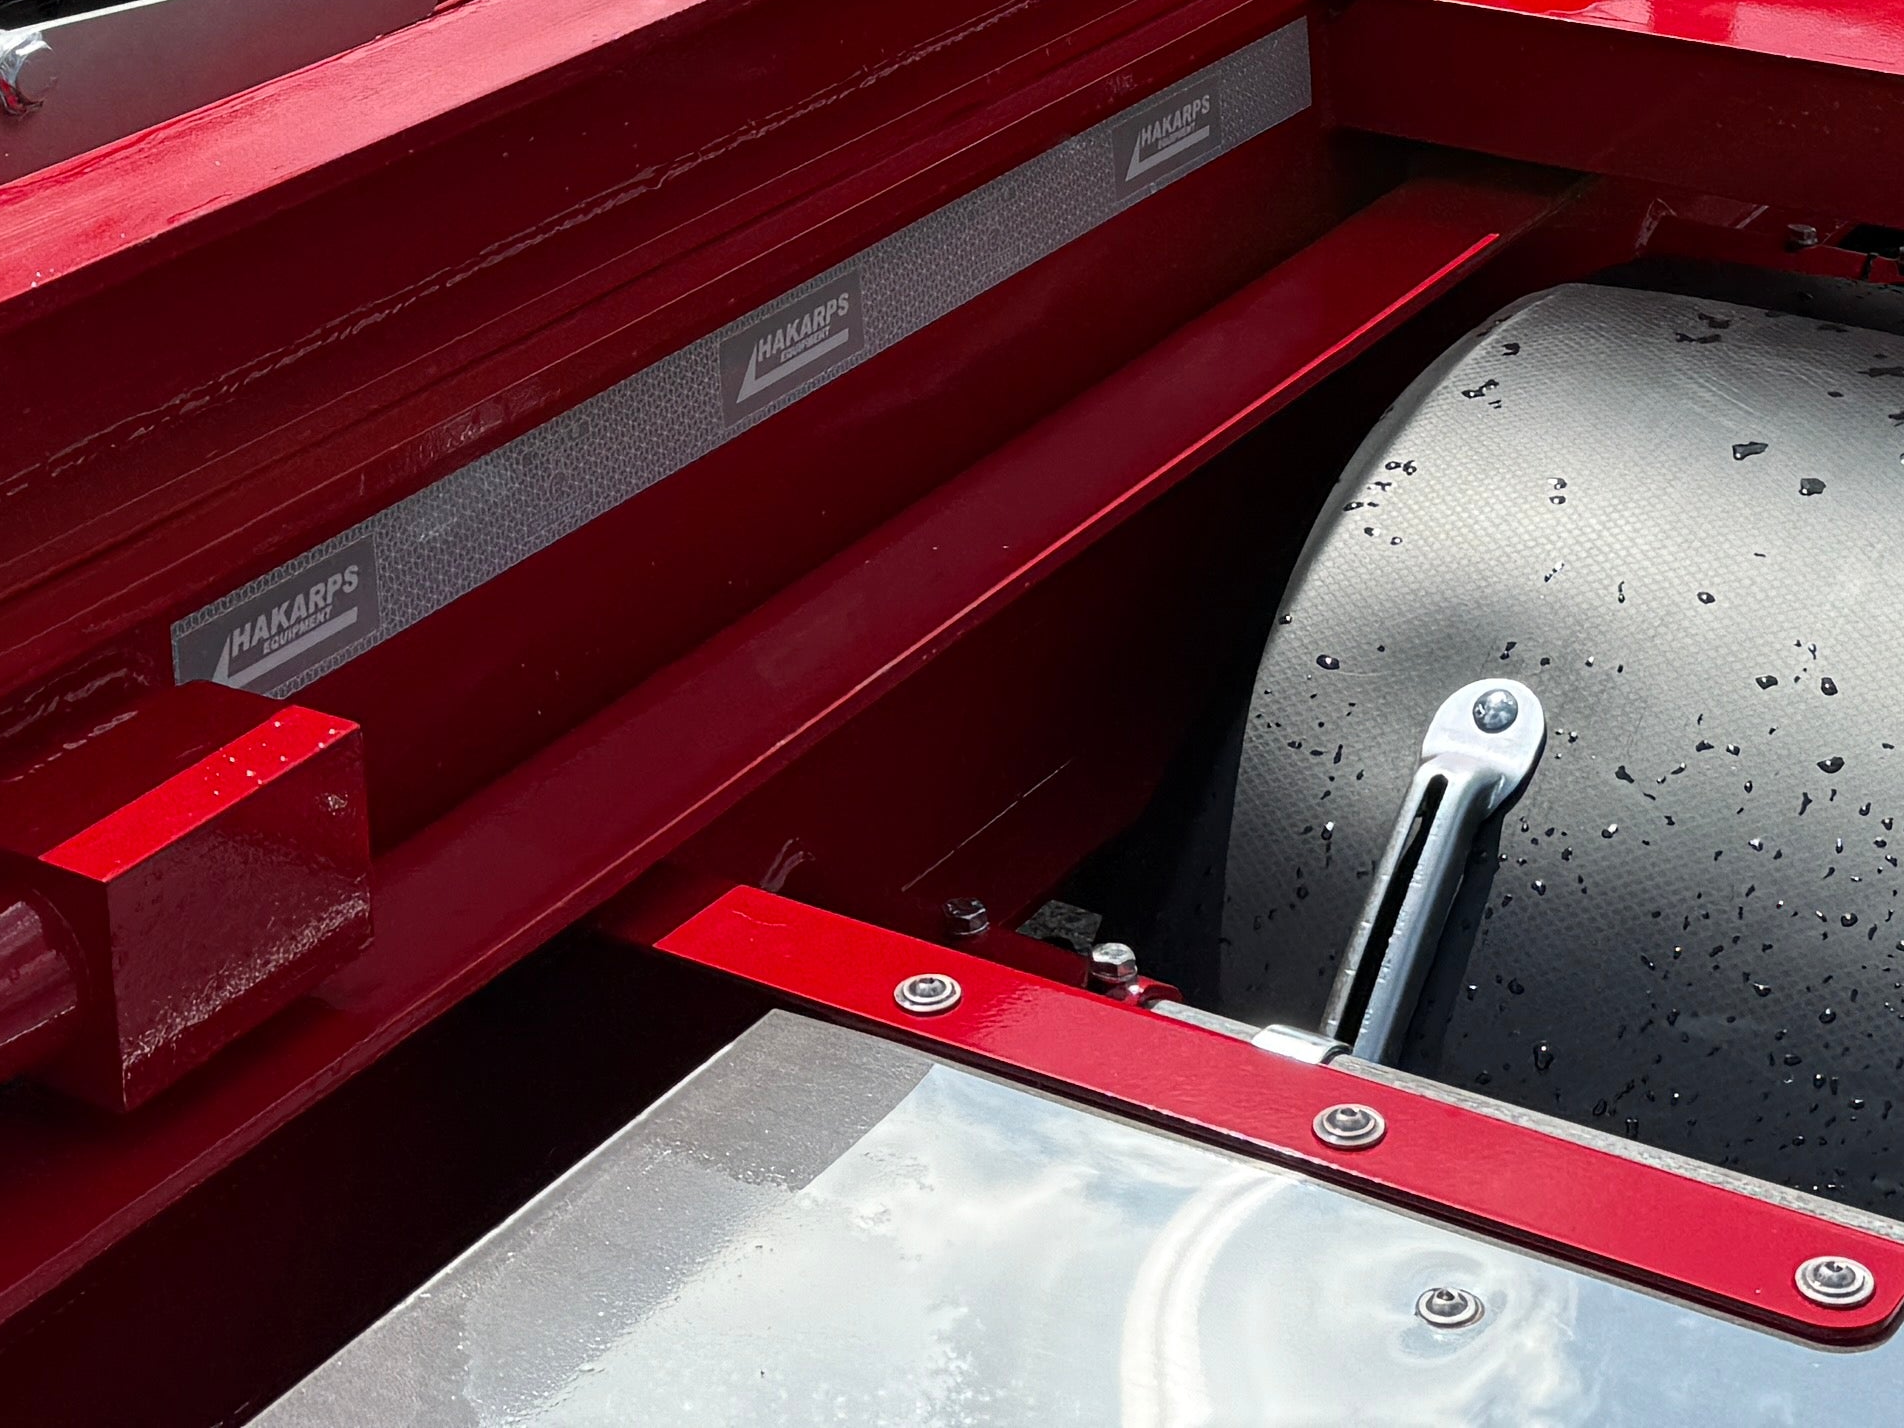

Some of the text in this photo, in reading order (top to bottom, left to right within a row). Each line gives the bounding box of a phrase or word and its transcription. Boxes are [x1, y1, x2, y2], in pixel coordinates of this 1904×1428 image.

[1141, 94, 1210, 148] HAKARPS
[757, 292, 850, 363] HAKARPS
[231, 564, 359, 658] HAKARPS
[263, 605, 332, 655] EQUIPMENT
